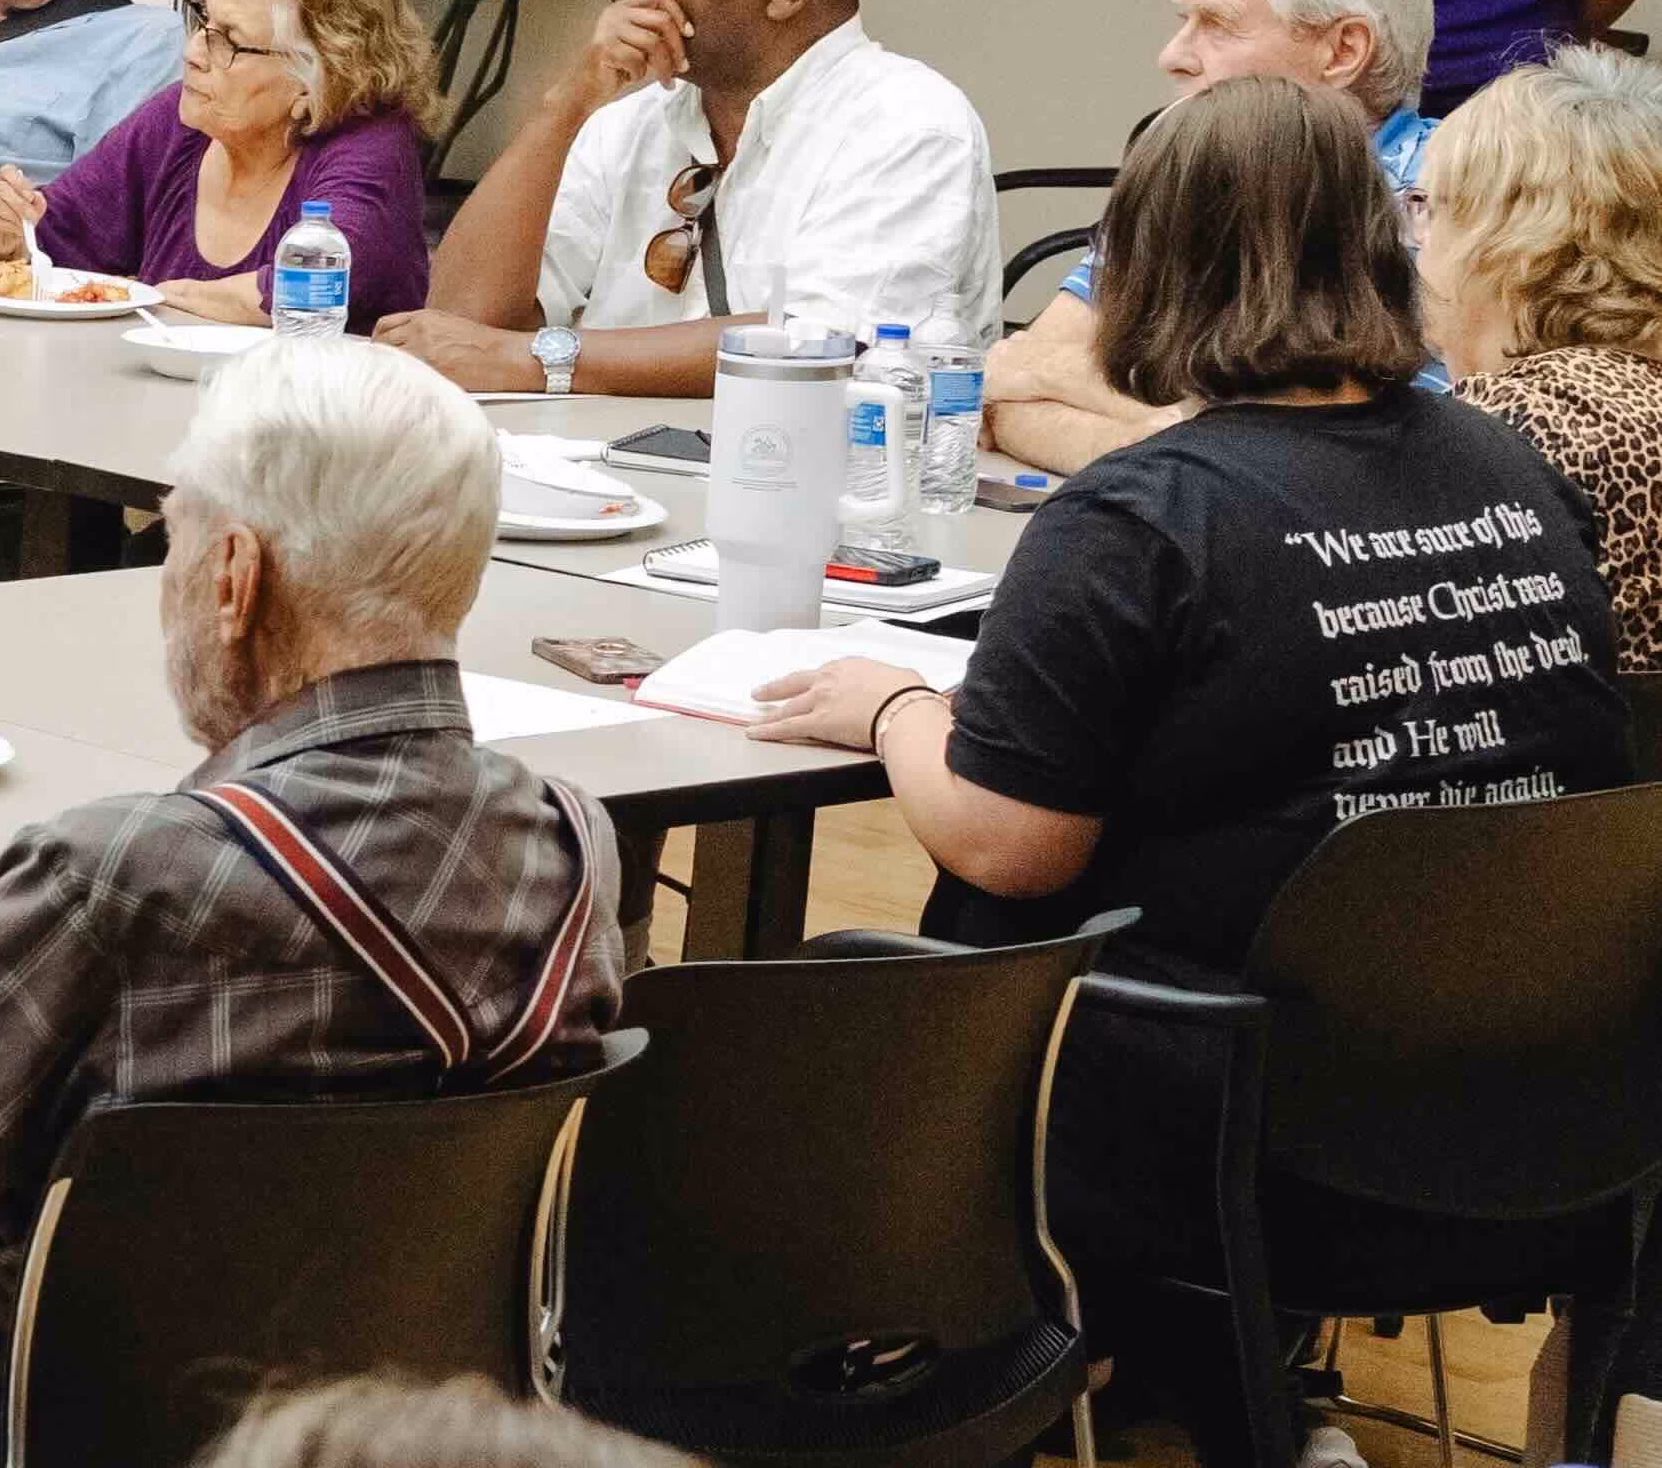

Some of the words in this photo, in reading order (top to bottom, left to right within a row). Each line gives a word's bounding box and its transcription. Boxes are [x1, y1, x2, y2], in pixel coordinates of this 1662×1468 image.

[1370, 530, 1416, 559] are
[1415, 521, 1473, 555] sure
[1470, 506, 1502, 548] of
[1494, 501, 1544, 543] this
[1313, 592, 1428, 639] because
[1428, 573, 1516, 621] Christ
[1513, 571, 1565, 606] was
[1330, 653, 1422, 707] raised
[1427, 650, 1494, 695] from
[1493, 640, 1535, 681] the
[1333, 726, 1398, 770] and
[1403, 718, 1450, 758] He
[1452, 709, 1506, 753] will
